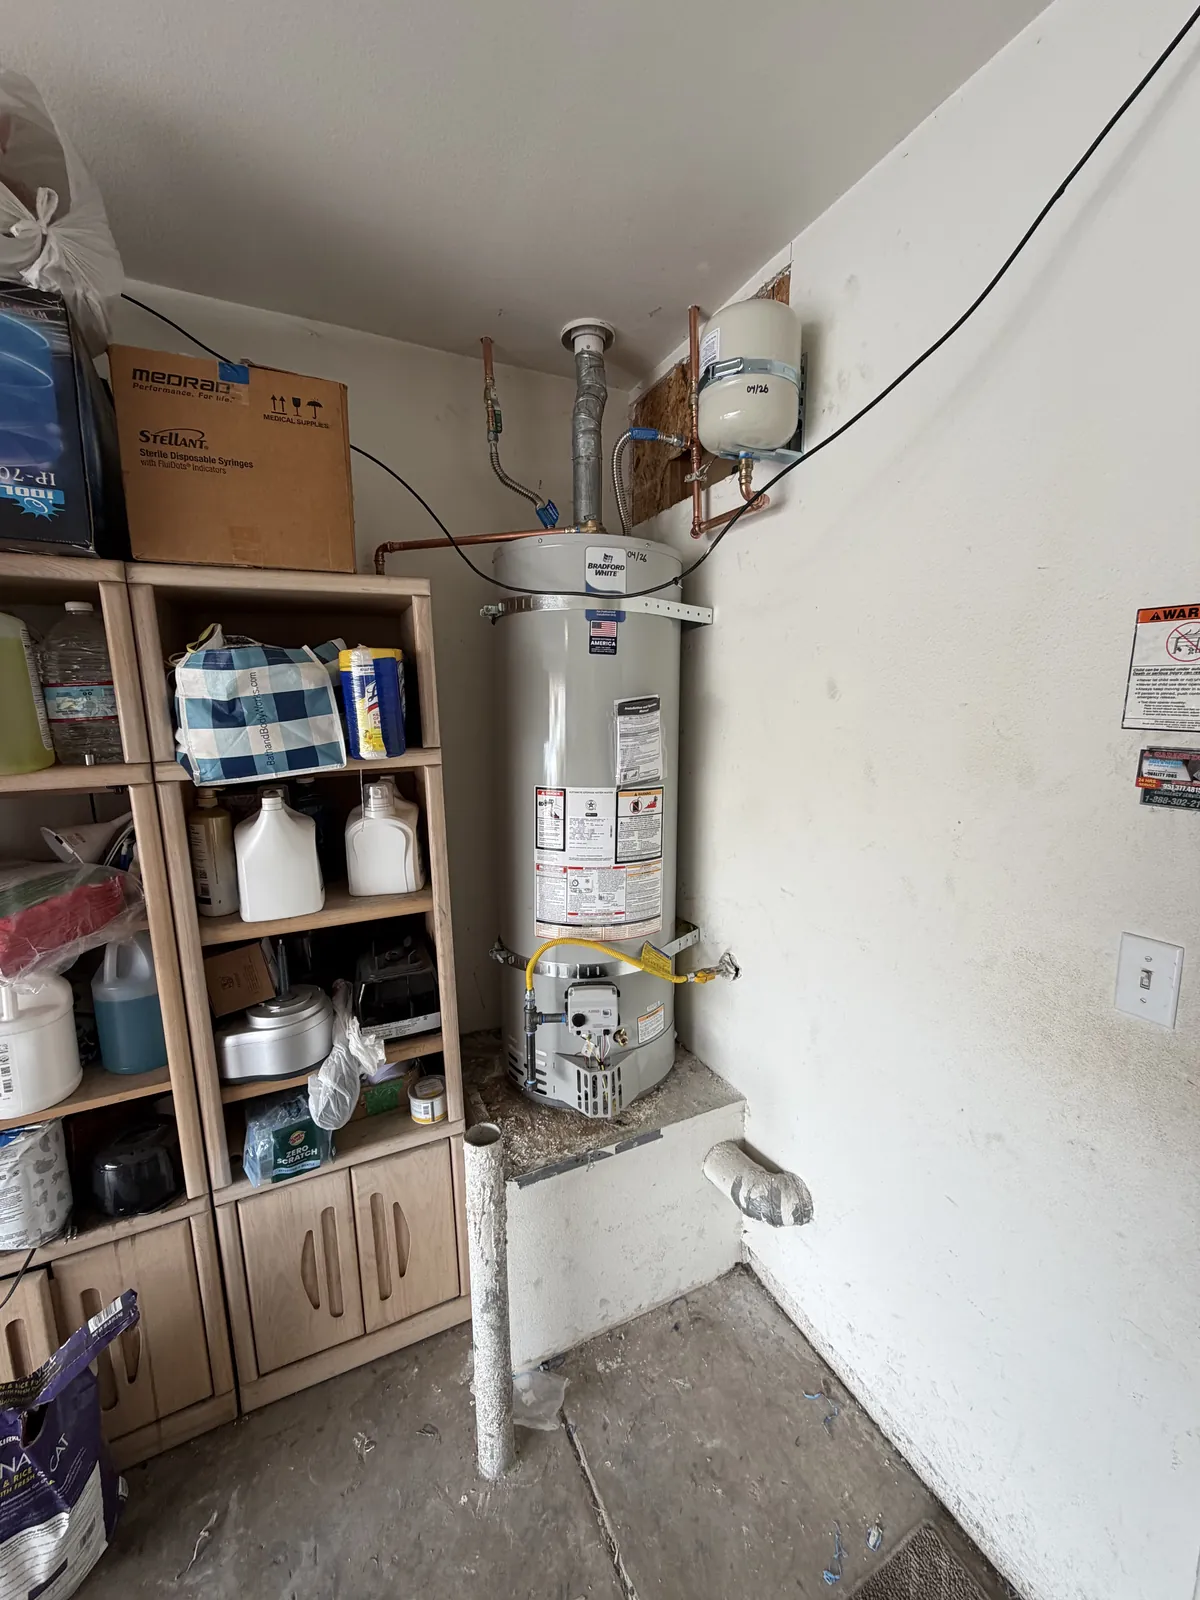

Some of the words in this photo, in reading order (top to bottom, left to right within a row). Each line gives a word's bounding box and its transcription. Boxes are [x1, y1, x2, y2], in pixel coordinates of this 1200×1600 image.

[746, 384, 769, 394] 04/26
[263, 413, 295, 425] MEDICAL
[296, 418, 330, 429] SUPPLIES
[139, 448, 169, 460] Sterile
[170, 451, 217, 465] Disposable
[217, 457, 254, 469] Syringes
[140, 459, 157, 468] with
[192, 464, 227, 475] Indicators
[626, 550, 648, 562] 04/26
[587, 562, 626, 571] BRADFORD
[594, 569, 618, 577] WHITE
[249, 671, 276, 766] BathandBodyWorks.com
[277, 1148, 318, 1165] SCRATCH
[286, 1145, 309, 1158] ZERO
[50, 1433, 68, 1472] CAT
[13, 1467, 32, 1482] RICE
